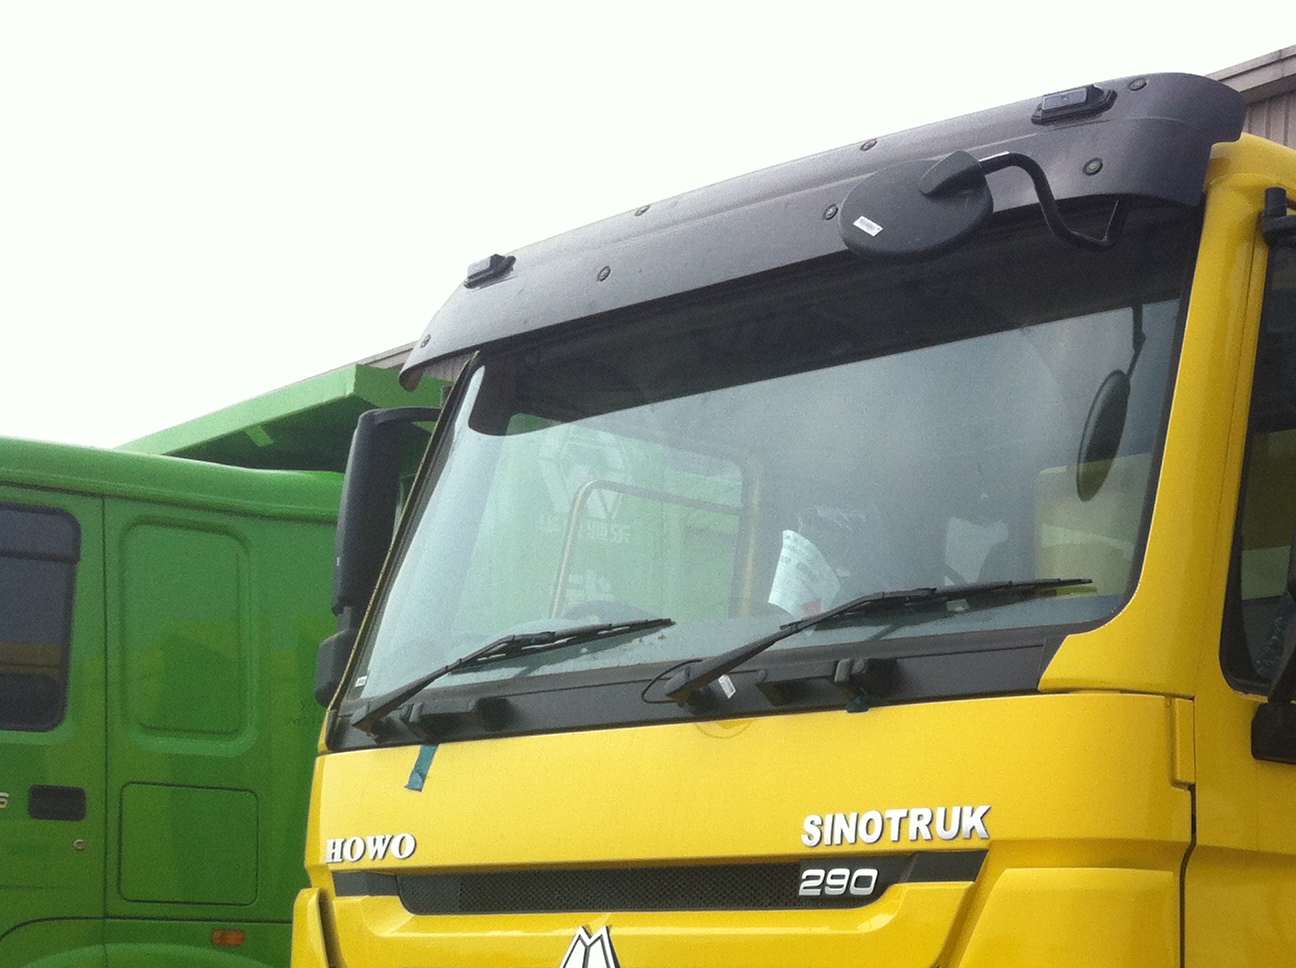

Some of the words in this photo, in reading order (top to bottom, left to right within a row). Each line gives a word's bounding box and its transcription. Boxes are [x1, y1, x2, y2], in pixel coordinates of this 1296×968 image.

[801, 805, 991, 847] SINOTRUK
[326, 833, 416, 863] HOWO
[798, 869, 878, 896] 290
